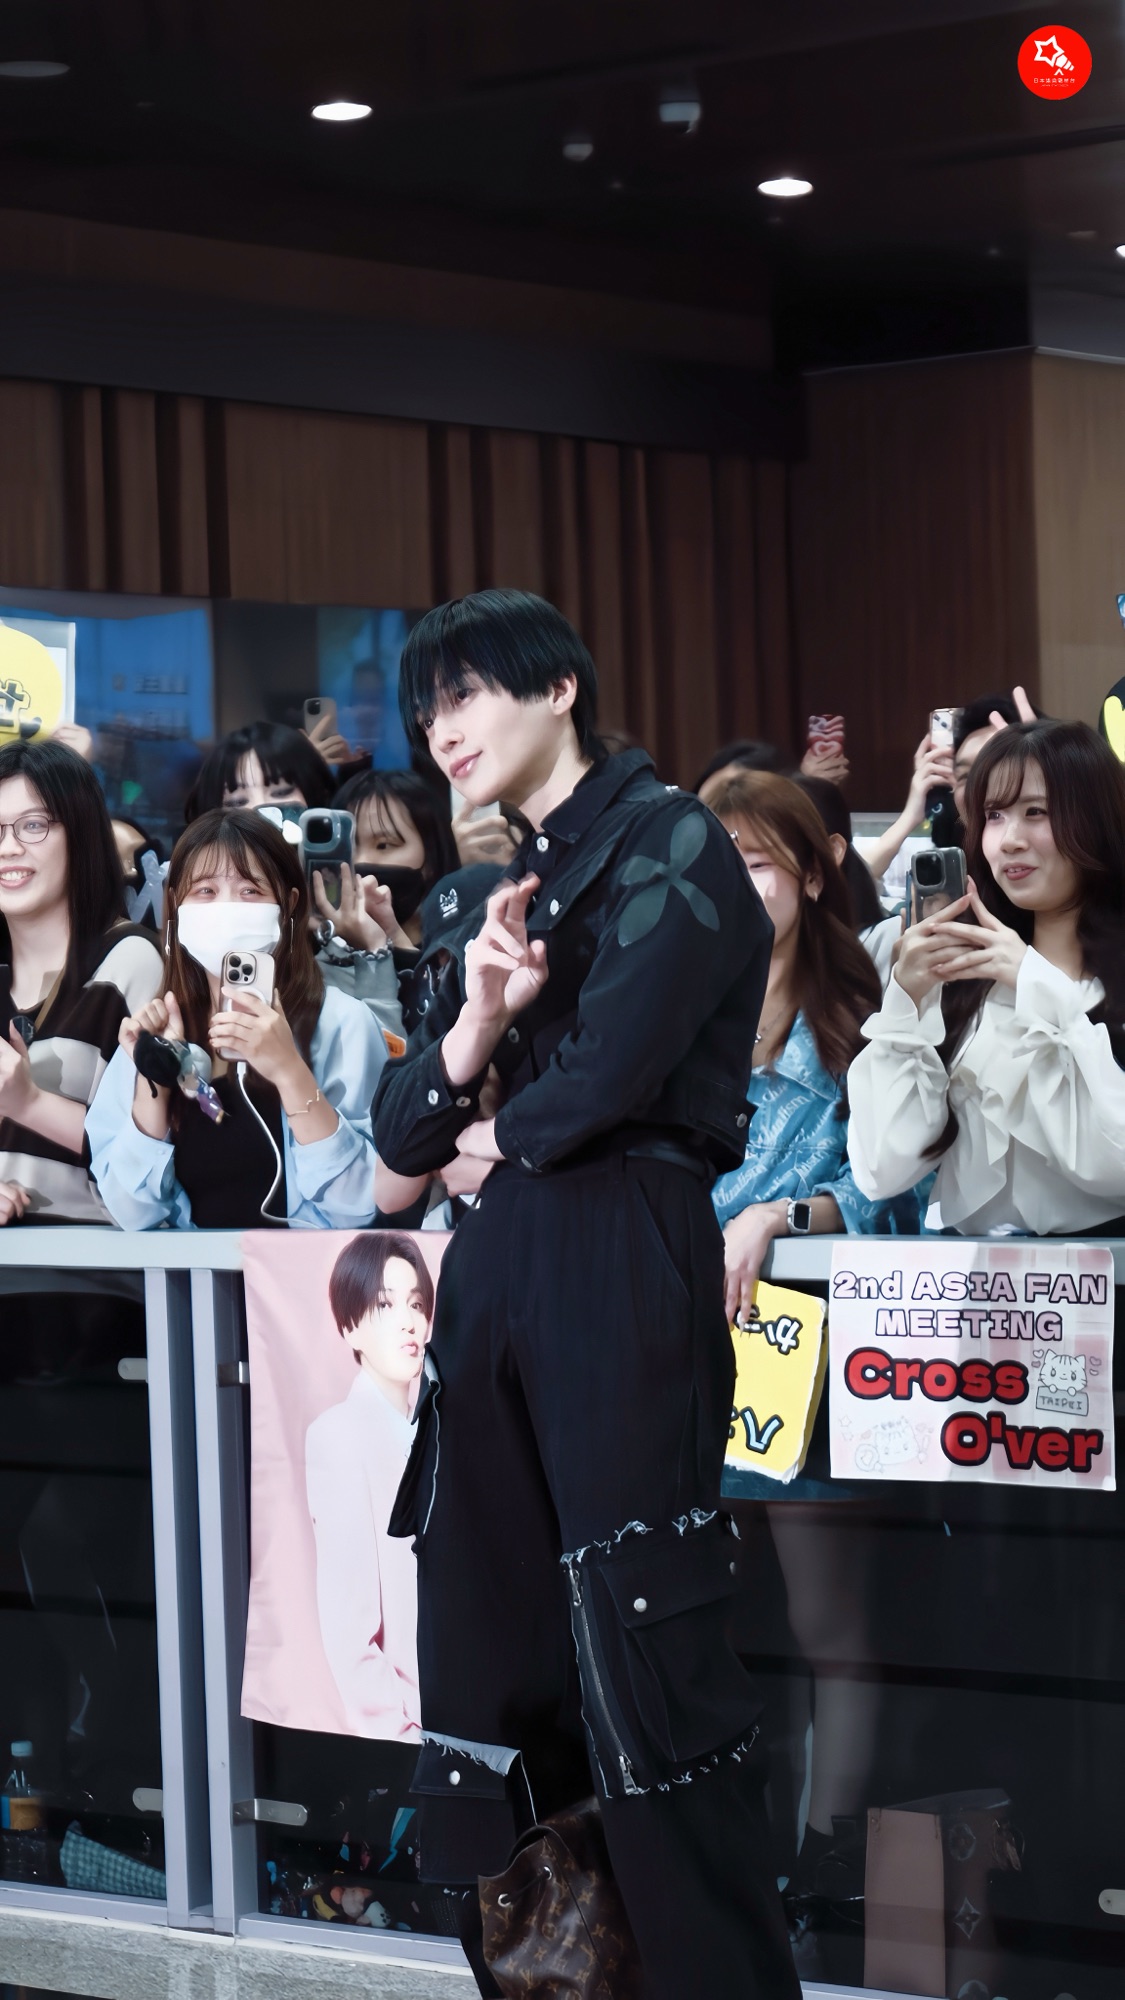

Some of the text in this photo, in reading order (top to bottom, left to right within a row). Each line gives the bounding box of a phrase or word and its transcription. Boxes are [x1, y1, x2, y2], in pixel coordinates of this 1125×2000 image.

[832, 1270, 1107, 1305] 2nd ASIA FAN
[874, 1308, 1063, 1342] MEETING
[844, 1346, 1030, 1405] Cross
[1038, 1395, 1083, 1410] TAIPEI
[940, 1410, 1105, 1473] O'ver
